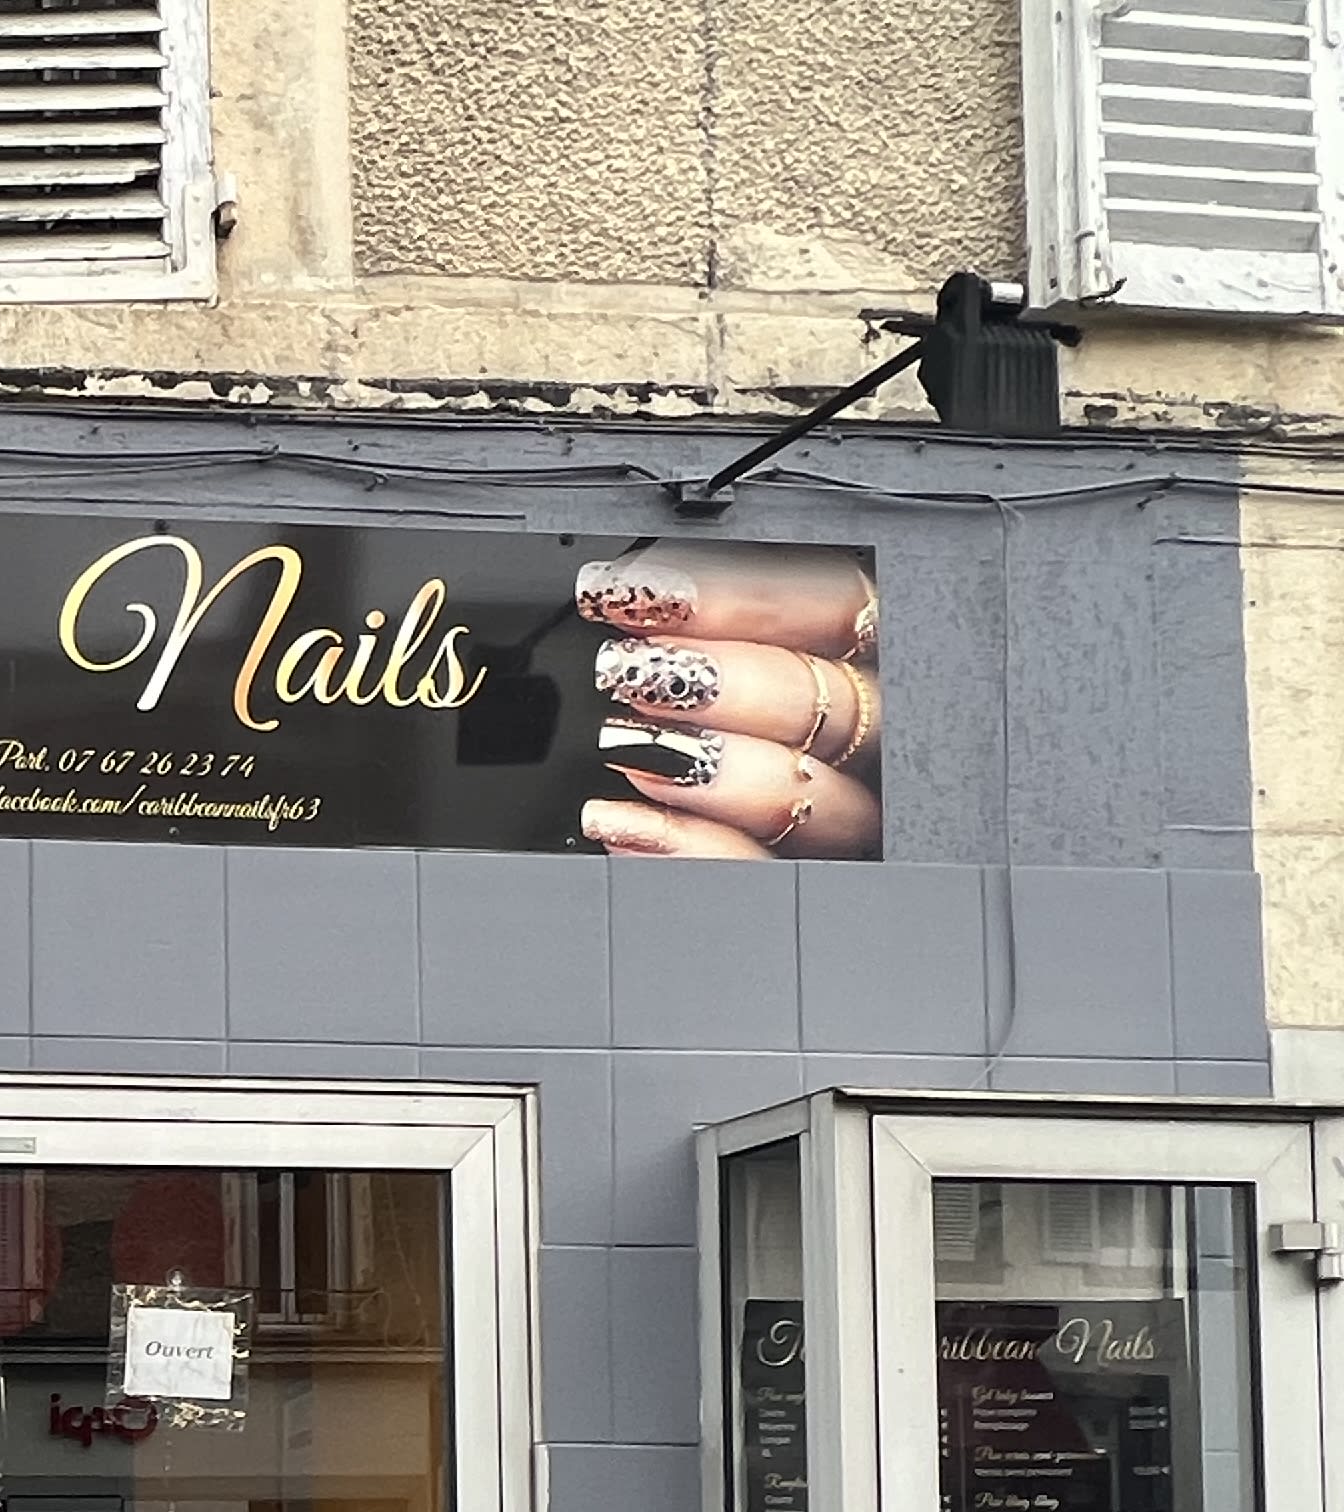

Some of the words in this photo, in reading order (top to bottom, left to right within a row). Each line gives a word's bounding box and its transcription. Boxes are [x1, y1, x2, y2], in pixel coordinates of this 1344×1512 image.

[58, 534, 487, 732] Nails
[58, 749, 95, 773] 07
[100, 750, 135, 774] 67
[139, 751, 173, 776] 26
[179, 752, 214, 777] 23
[220, 753, 257, 778] 74
[145, 1340, 215, 1360] Ouvert
[1056, 1318, 1156, 1367] Nails
